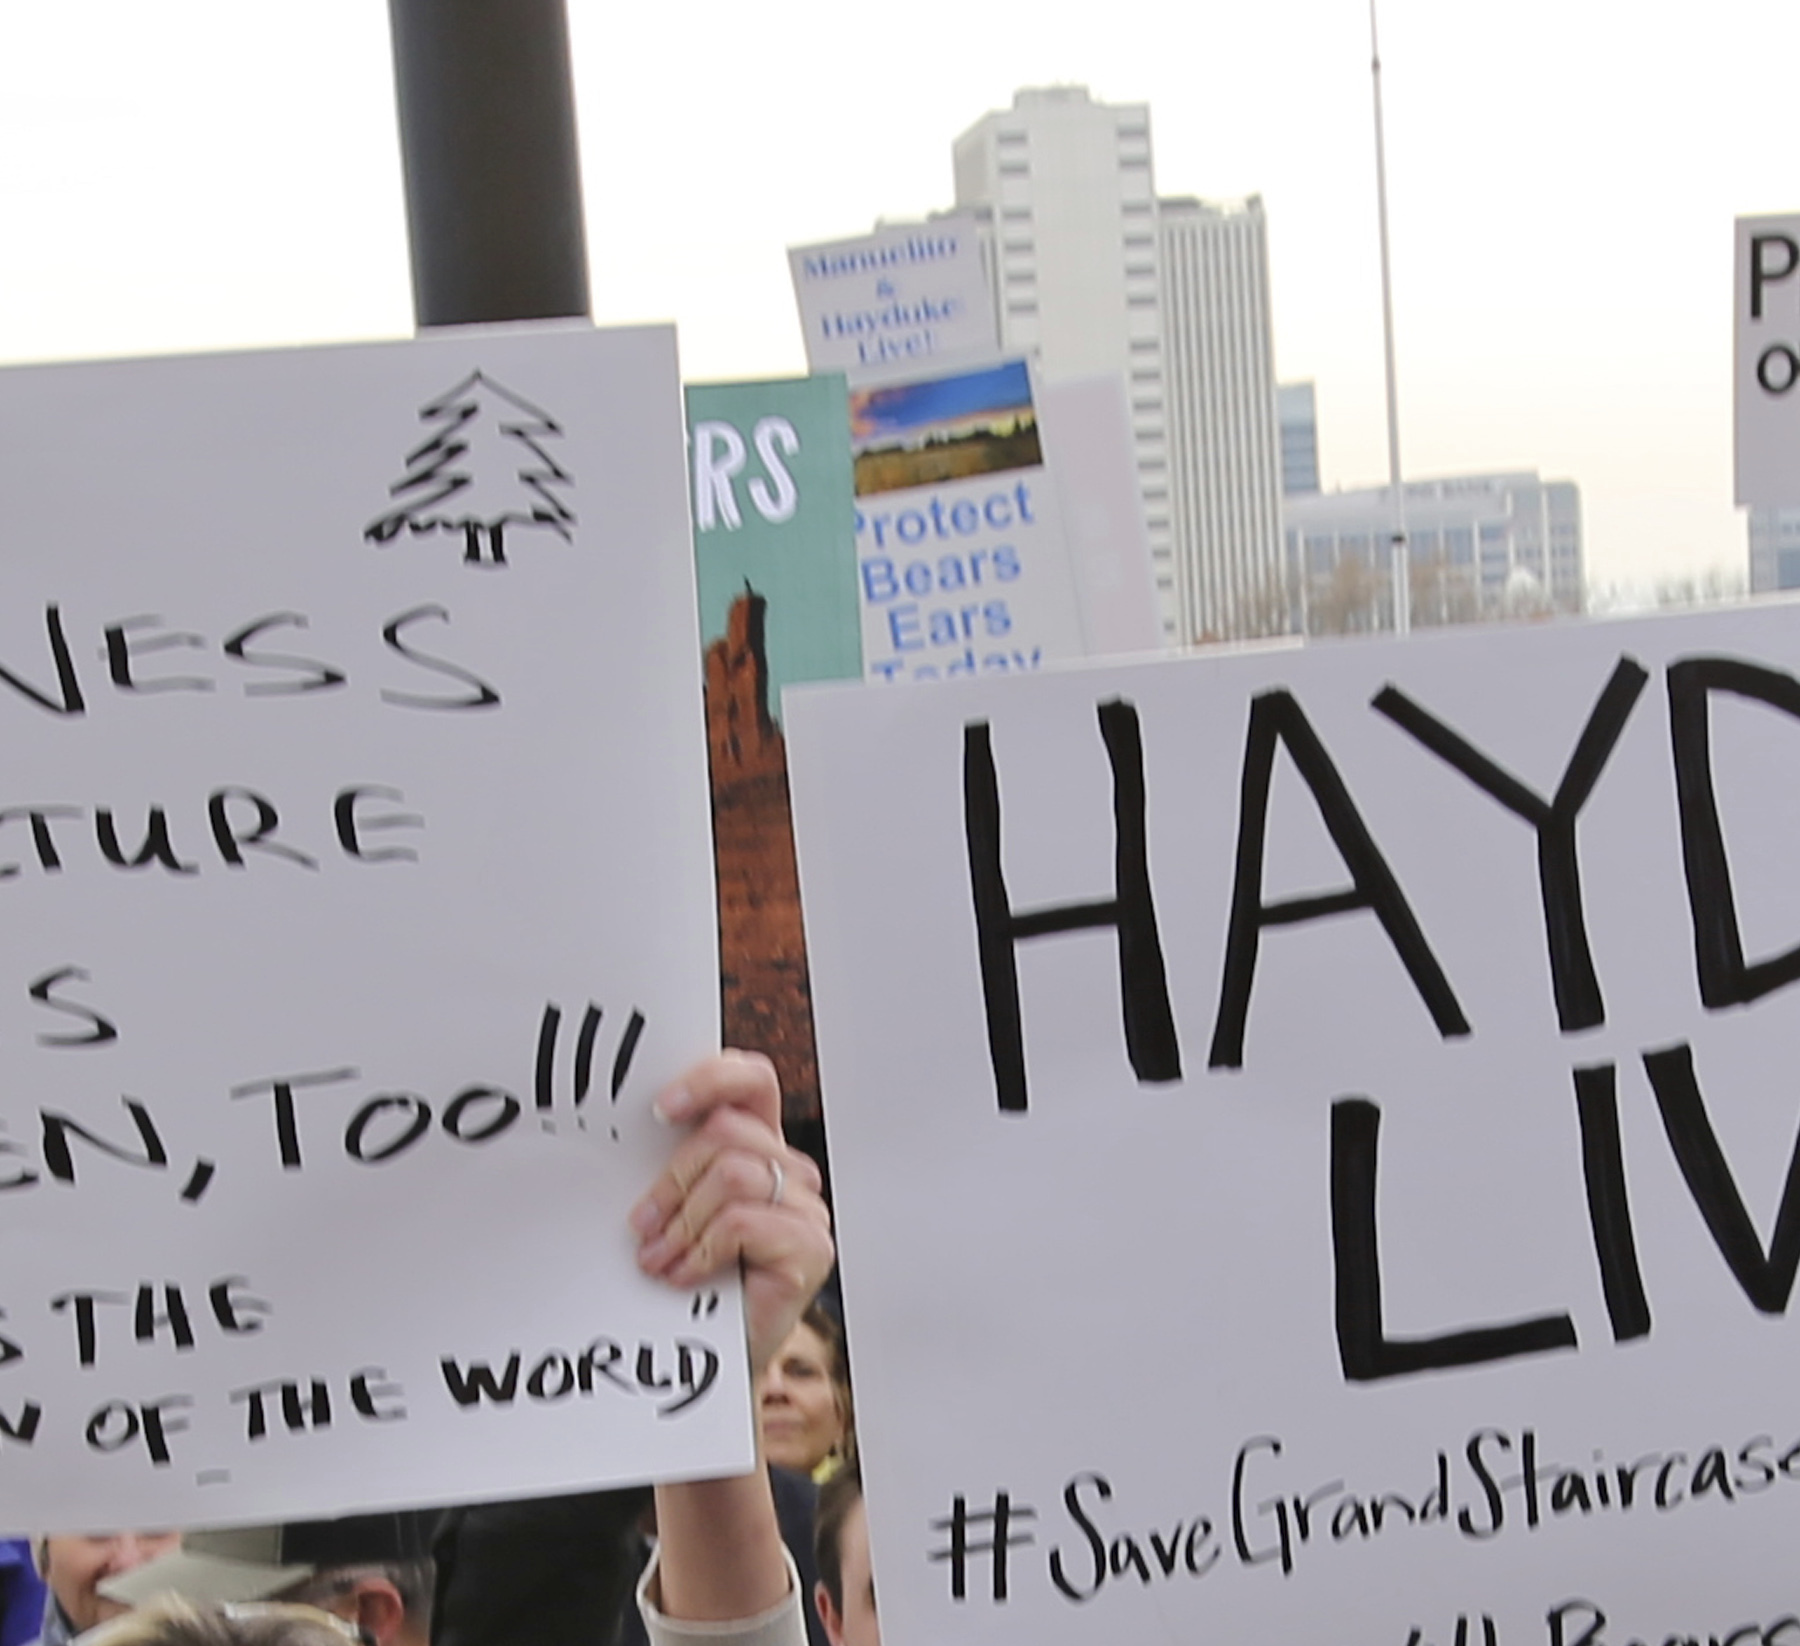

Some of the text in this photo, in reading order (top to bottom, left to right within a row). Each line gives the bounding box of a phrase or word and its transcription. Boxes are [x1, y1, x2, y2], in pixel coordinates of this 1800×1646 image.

[802, 233, 959, 278] Manuelito
[876, 277, 897, 299] &
[821, 293, 957, 341] Hayduke
[856, 329, 936, 366] Live!
[860, 544, 1022, 603] Bears
[887, 599, 1013, 651] Ears
[230, 999, 647, 1171] TOO!!!
[51, 1274, 273, 1369] THE
[84, 1395, 191, 1466] OF
[230, 1366, 410, 1440] THE
